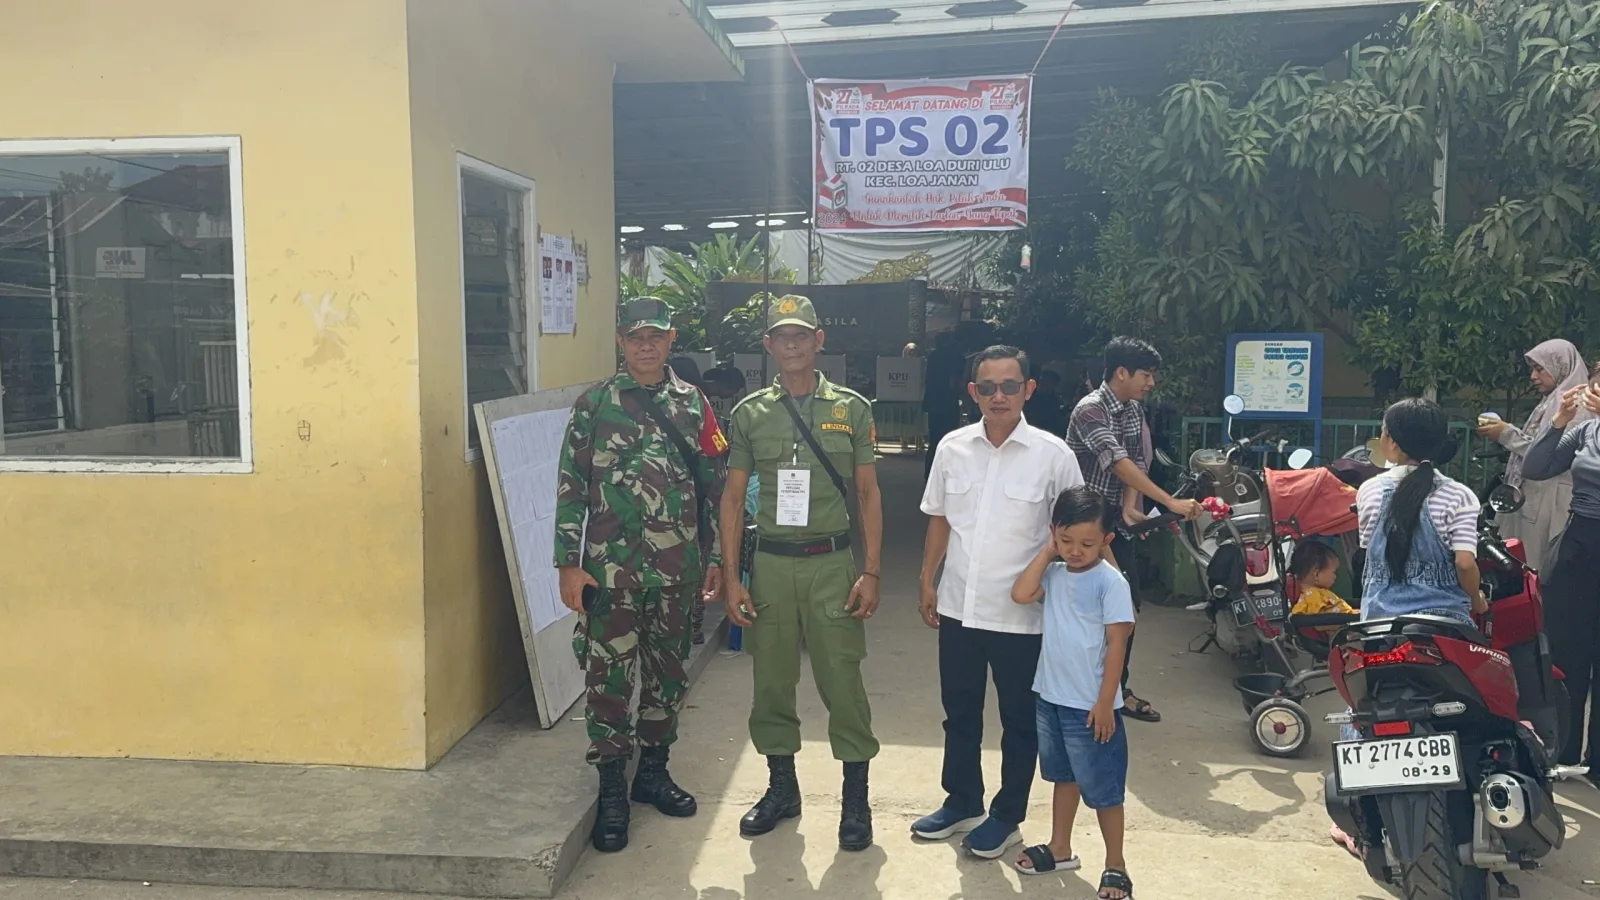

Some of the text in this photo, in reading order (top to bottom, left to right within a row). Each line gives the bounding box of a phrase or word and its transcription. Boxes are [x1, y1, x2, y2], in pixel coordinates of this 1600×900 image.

[864, 100, 919, 111] SELAMAT
[922, 98, 968, 110] DATANG
[970, 98, 985, 109] DI
[829, 114, 1009, 157] TPS 02
[835, 157, 1011, 173] RT. 02 DESA LOA DURI ULU
[865, 174, 979, 187] KEC. LOA JANAN
[926, 191, 944, 203] Hak
[818, 212, 846, 224] 2024
[888, 372, 909, 381] KPU
[825, 423, 852, 432] LINMAS
[1234, 601, 1247, 614] KT
[1342, 738, 1451, 765] KT 2774 CBB
